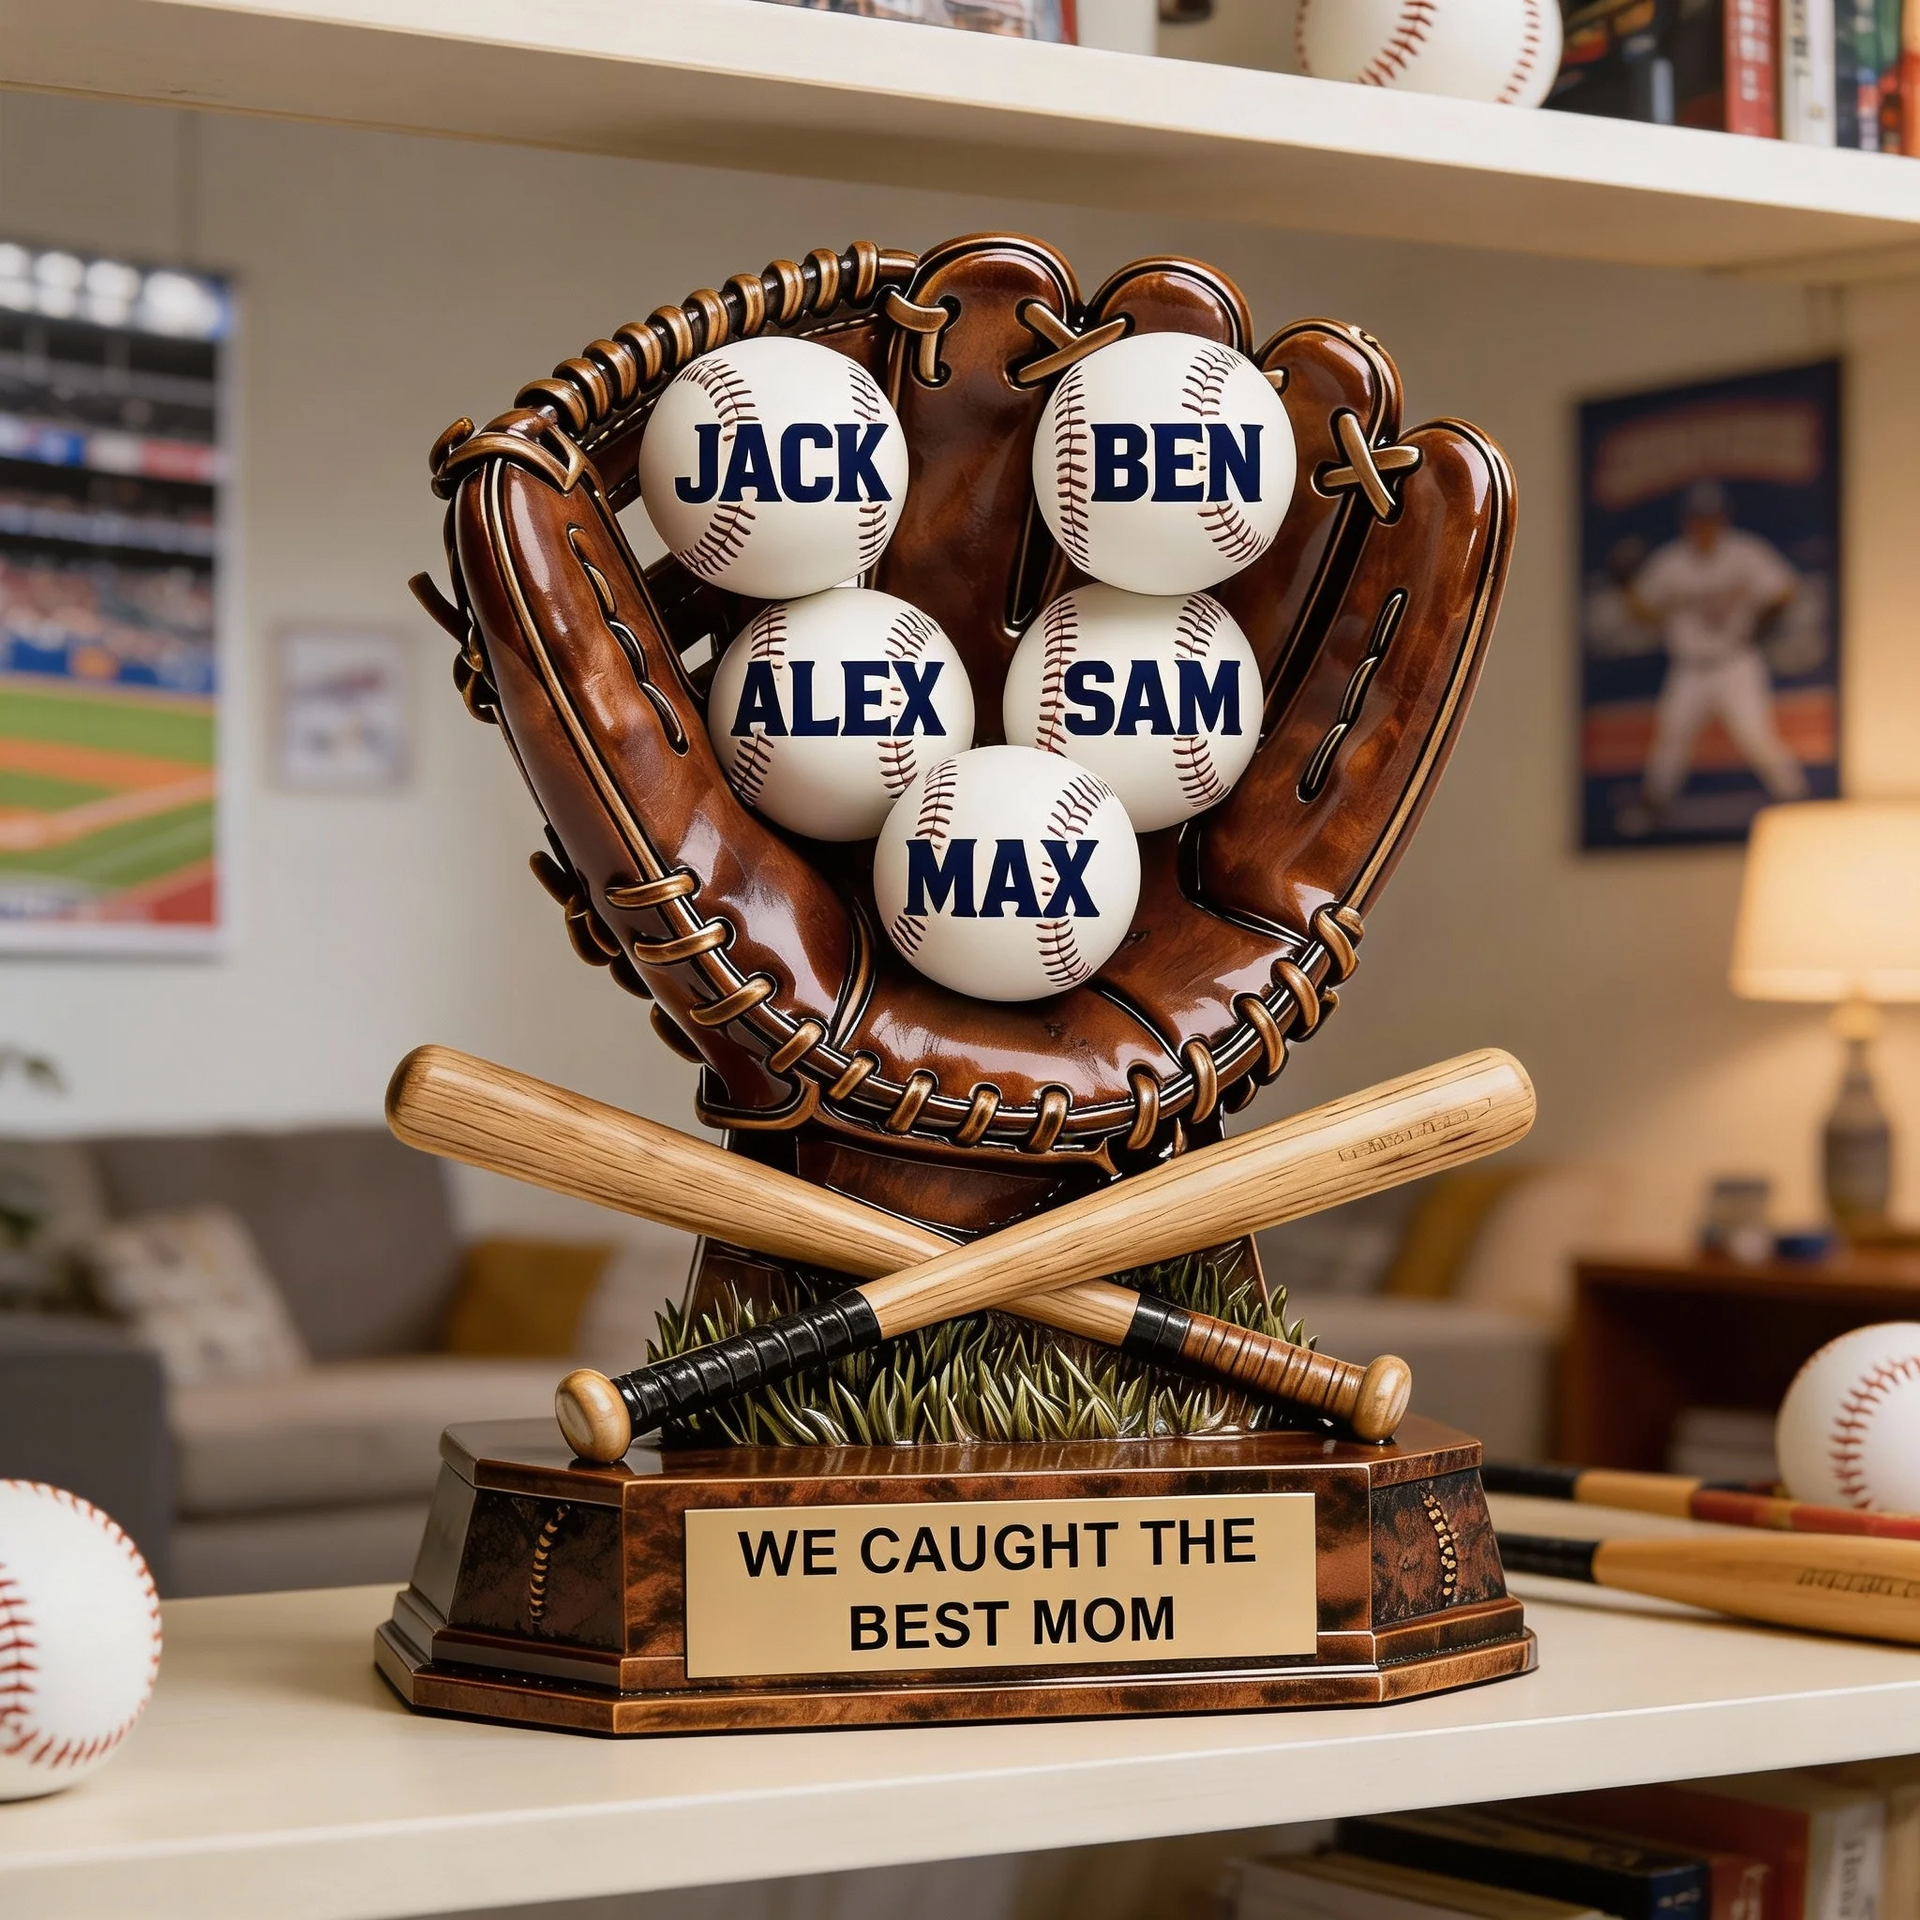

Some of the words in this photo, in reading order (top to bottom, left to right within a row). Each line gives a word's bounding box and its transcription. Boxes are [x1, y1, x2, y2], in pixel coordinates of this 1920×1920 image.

[675, 423, 892, 503] JACK
[1090, 423, 1261, 502] BEN
[730, 660, 947, 736] ALEX
[1064, 660, 1242, 736] SAM
[904, 839, 1100, 917] MAX
[738, 1529, 837, 1577] WE
[860, 1521, 1119, 1574] CAUGHT
[1140, 1517, 1256, 1565] THE
[850, 1600, 1010, 1651] BEST
[1034, 1596, 1175, 1645] MOM
